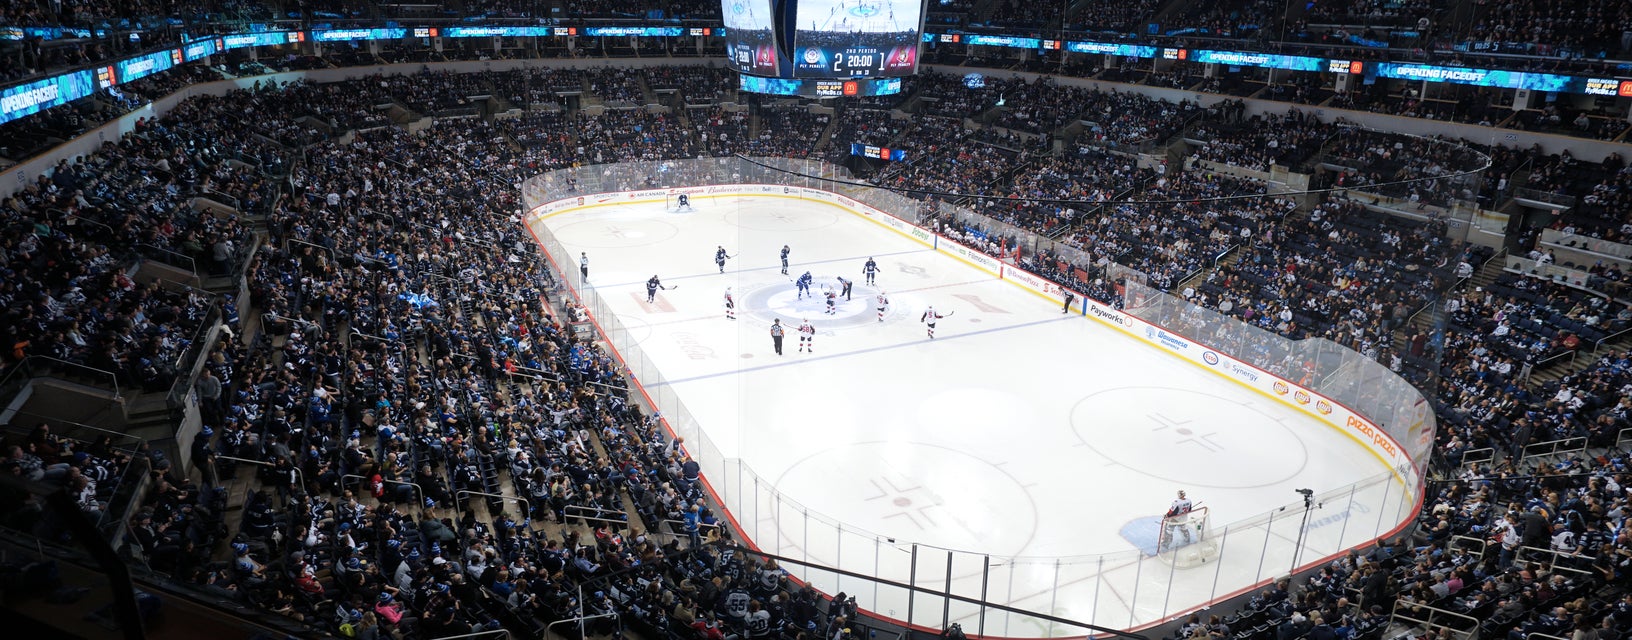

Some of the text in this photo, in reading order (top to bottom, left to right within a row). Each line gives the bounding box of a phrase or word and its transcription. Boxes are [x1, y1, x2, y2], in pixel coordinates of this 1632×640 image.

[834, 53, 885, 72] 2 20:00 1
[1210, 53, 1269, 64] OPENING FACEOFF
[1397, 67, 1486, 81] OPENING FACEOFF
[1, 84, 59, 114] OPENING FACEOFF
[708, 186, 742, 194] Budweiser
[1090, 304, 1124, 325] Payworks
[1158, 330, 1188, 349] Wawanesa
[1205, 353, 1217, 363] Esso
[1232, 364, 1259, 382] Synergy
[1346, 415, 1397, 458] pizza pizza
[731, 599, 745, 611] 55
[751, 619, 765, 630] 20
